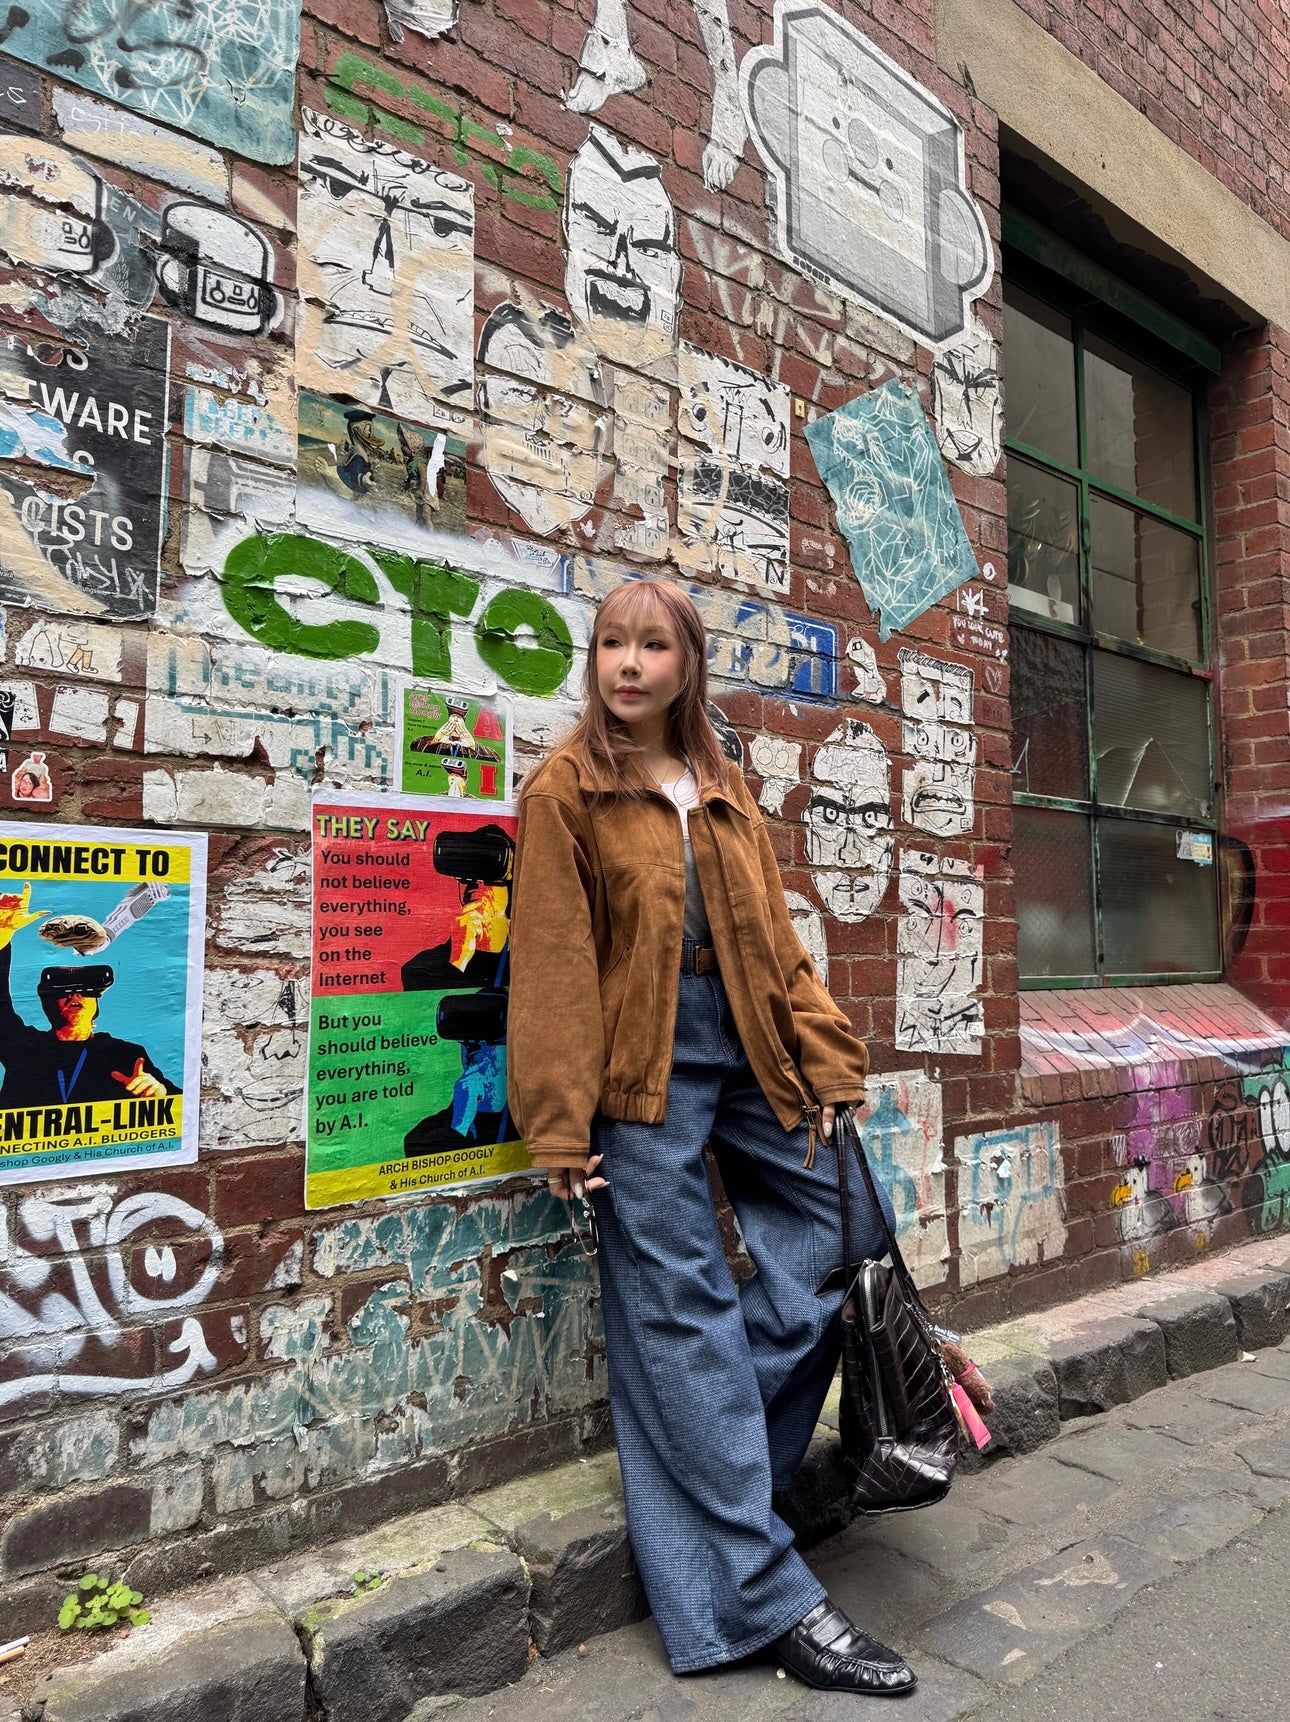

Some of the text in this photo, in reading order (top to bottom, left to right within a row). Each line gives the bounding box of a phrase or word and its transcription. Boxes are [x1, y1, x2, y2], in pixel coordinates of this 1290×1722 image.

[415, 768, 432, 778] A.I.
[316, 814, 430, 842] THEY SAY
[135, 849, 170, 877] TO
[321, 850, 410, 867] You should
[320, 875, 411, 889] not believe
[319, 899, 412, 916] everything,
[319, 925, 383, 942] you see
[319, 947, 372, 962] on the
[319, 971, 387, 987] Internet
[318, 1014, 382, 1032] But you
[317, 1034, 438, 1056] should believe
[316, 1060, 411, 1082] everything,
[315, 1081, 414, 1111] you are told
[0, 1098, 175, 1142] NTRAL-LINK
[315, 1112, 369, 1136] by A.I.
[73, 1136, 97, 1147] A.I.
[101, 1127, 177, 1144] BLUDGERS
[31, 1150, 71, 1165] Googly
[73, 1151, 82, 1160] &
[84, 1148, 102, 1159] His
[104, 1145, 143, 1157] Church
[145, 1141, 157, 1152] of
[157, 1141, 175, 1151] A.I.
[378, 1147, 495, 1176] ARCH BISHOP GOOGLY
[389, 1164, 486, 1190] & His Church of A.I.
